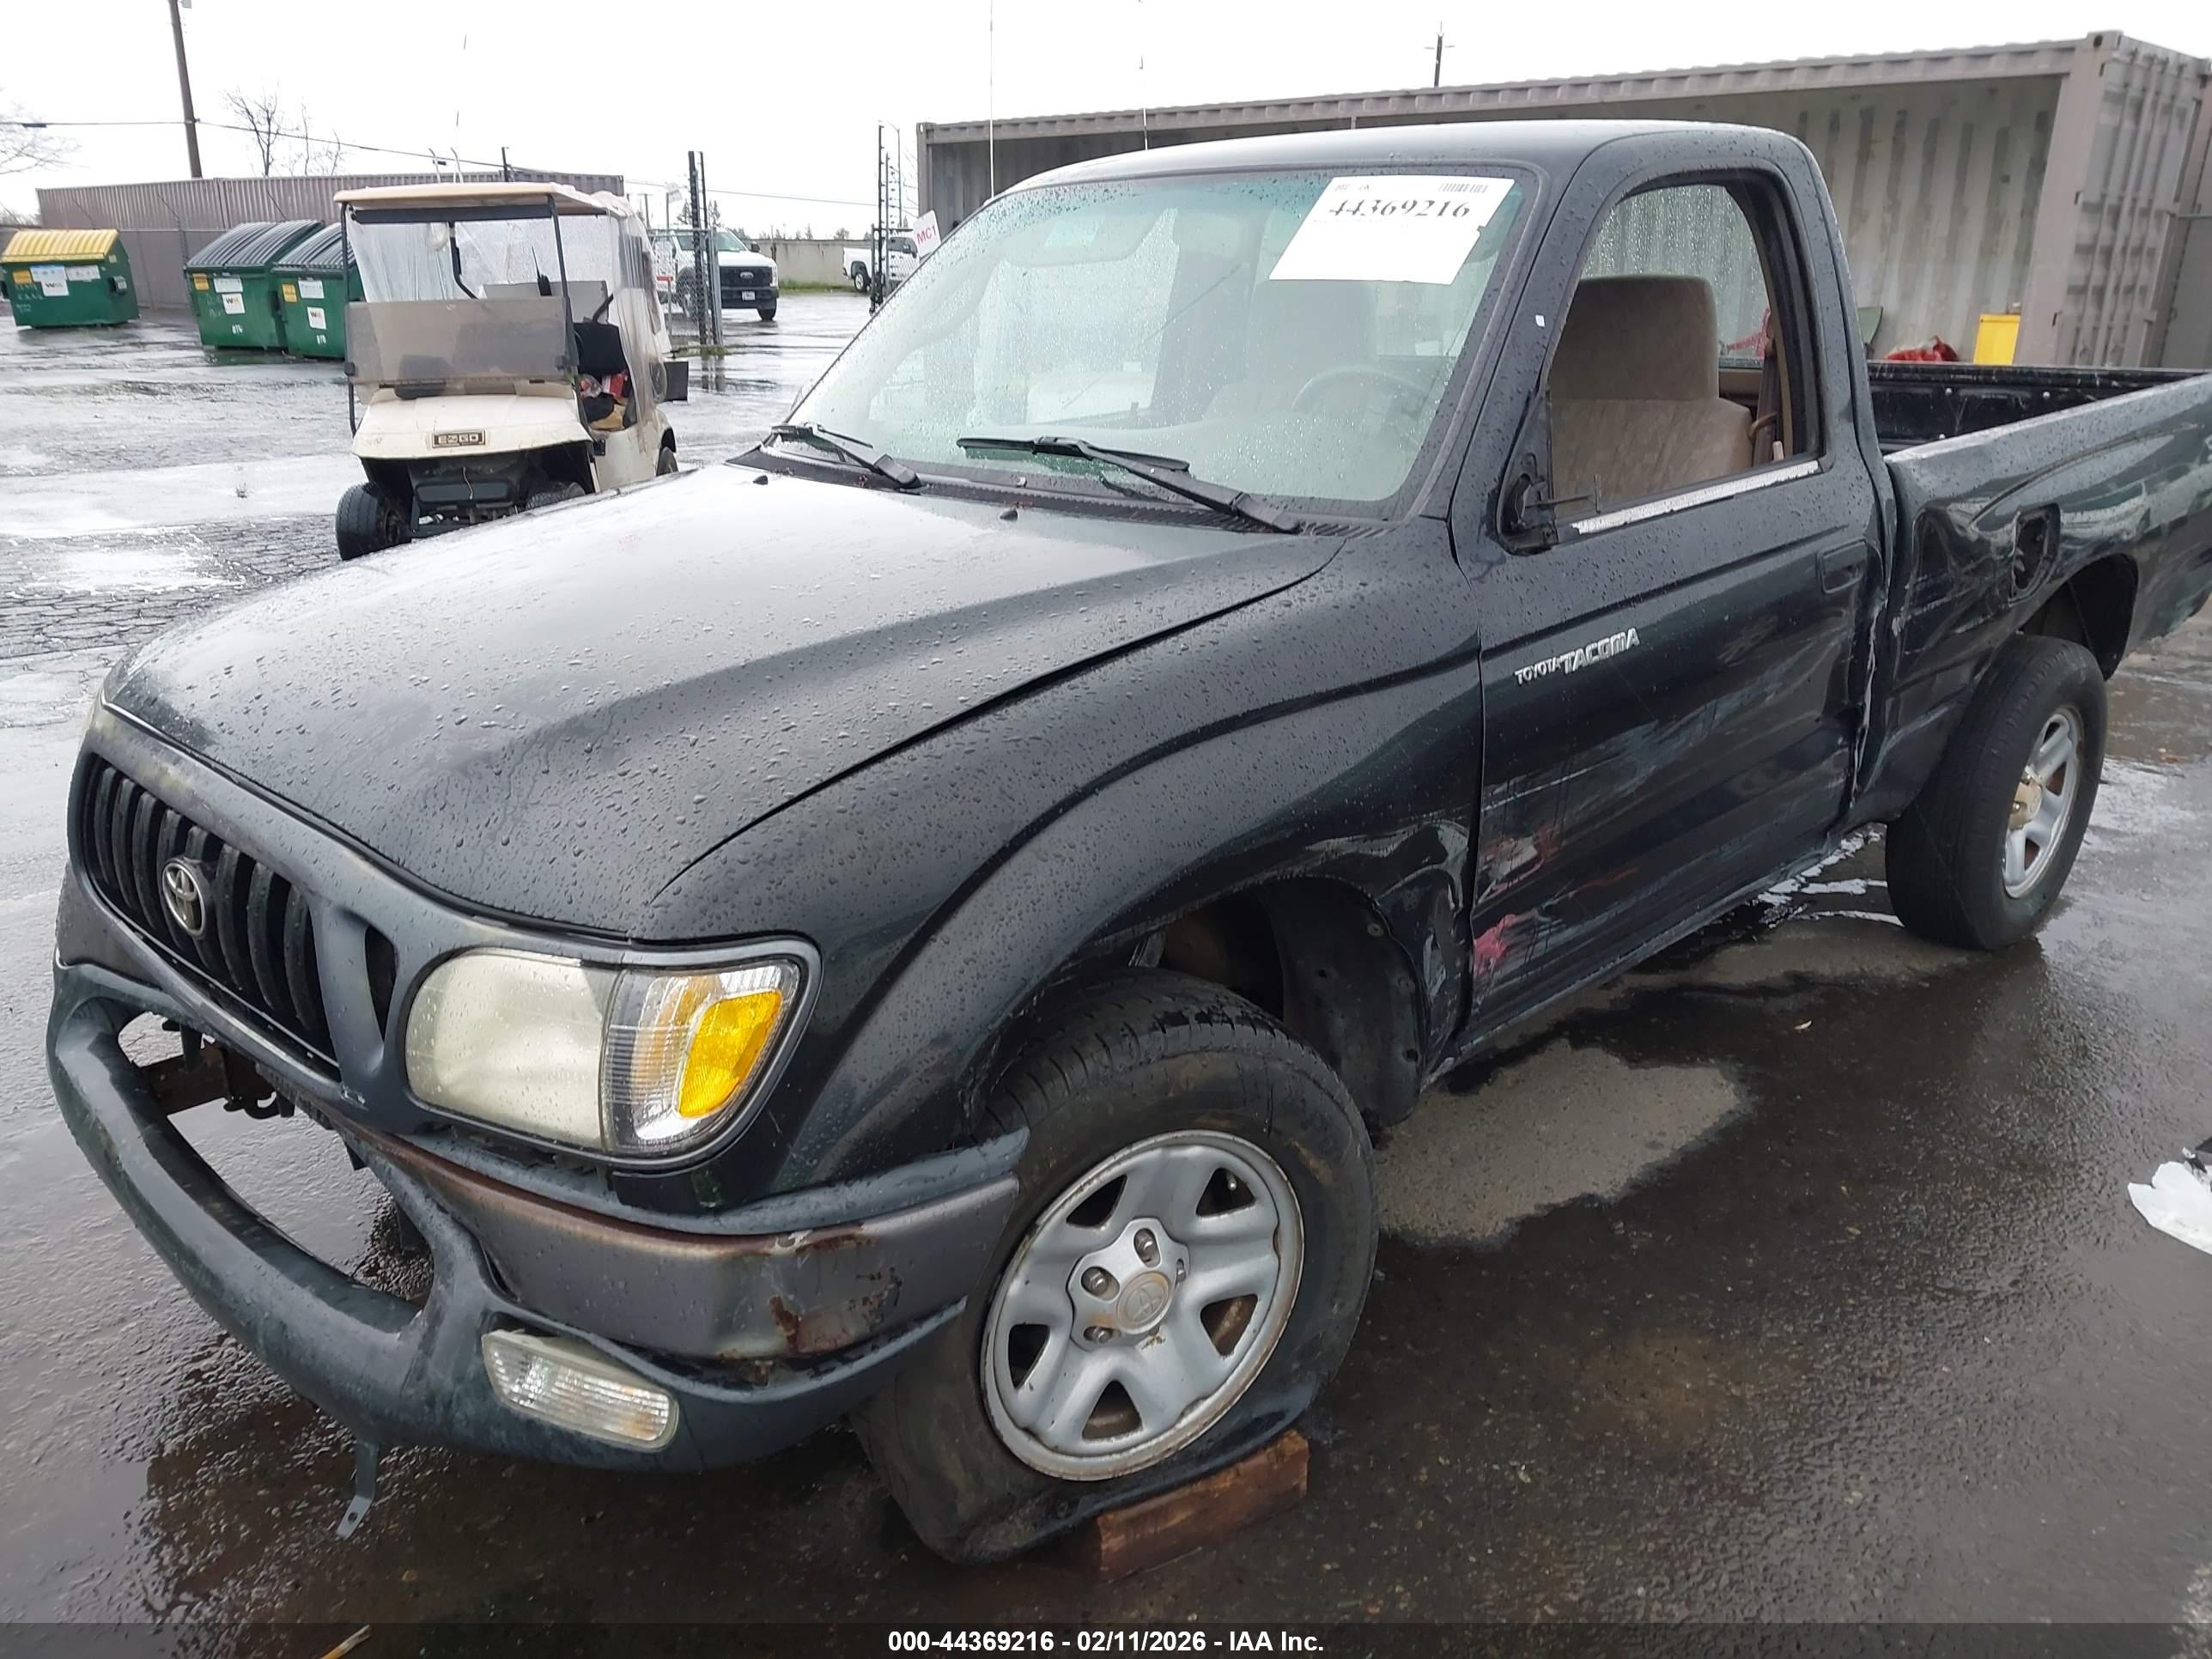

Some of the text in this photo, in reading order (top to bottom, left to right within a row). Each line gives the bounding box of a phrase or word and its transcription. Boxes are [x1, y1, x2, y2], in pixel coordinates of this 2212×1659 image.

[1328, 199, 1470, 216] 44369216
[1514, 628, 1640, 685] TOYOTA TACOMA
